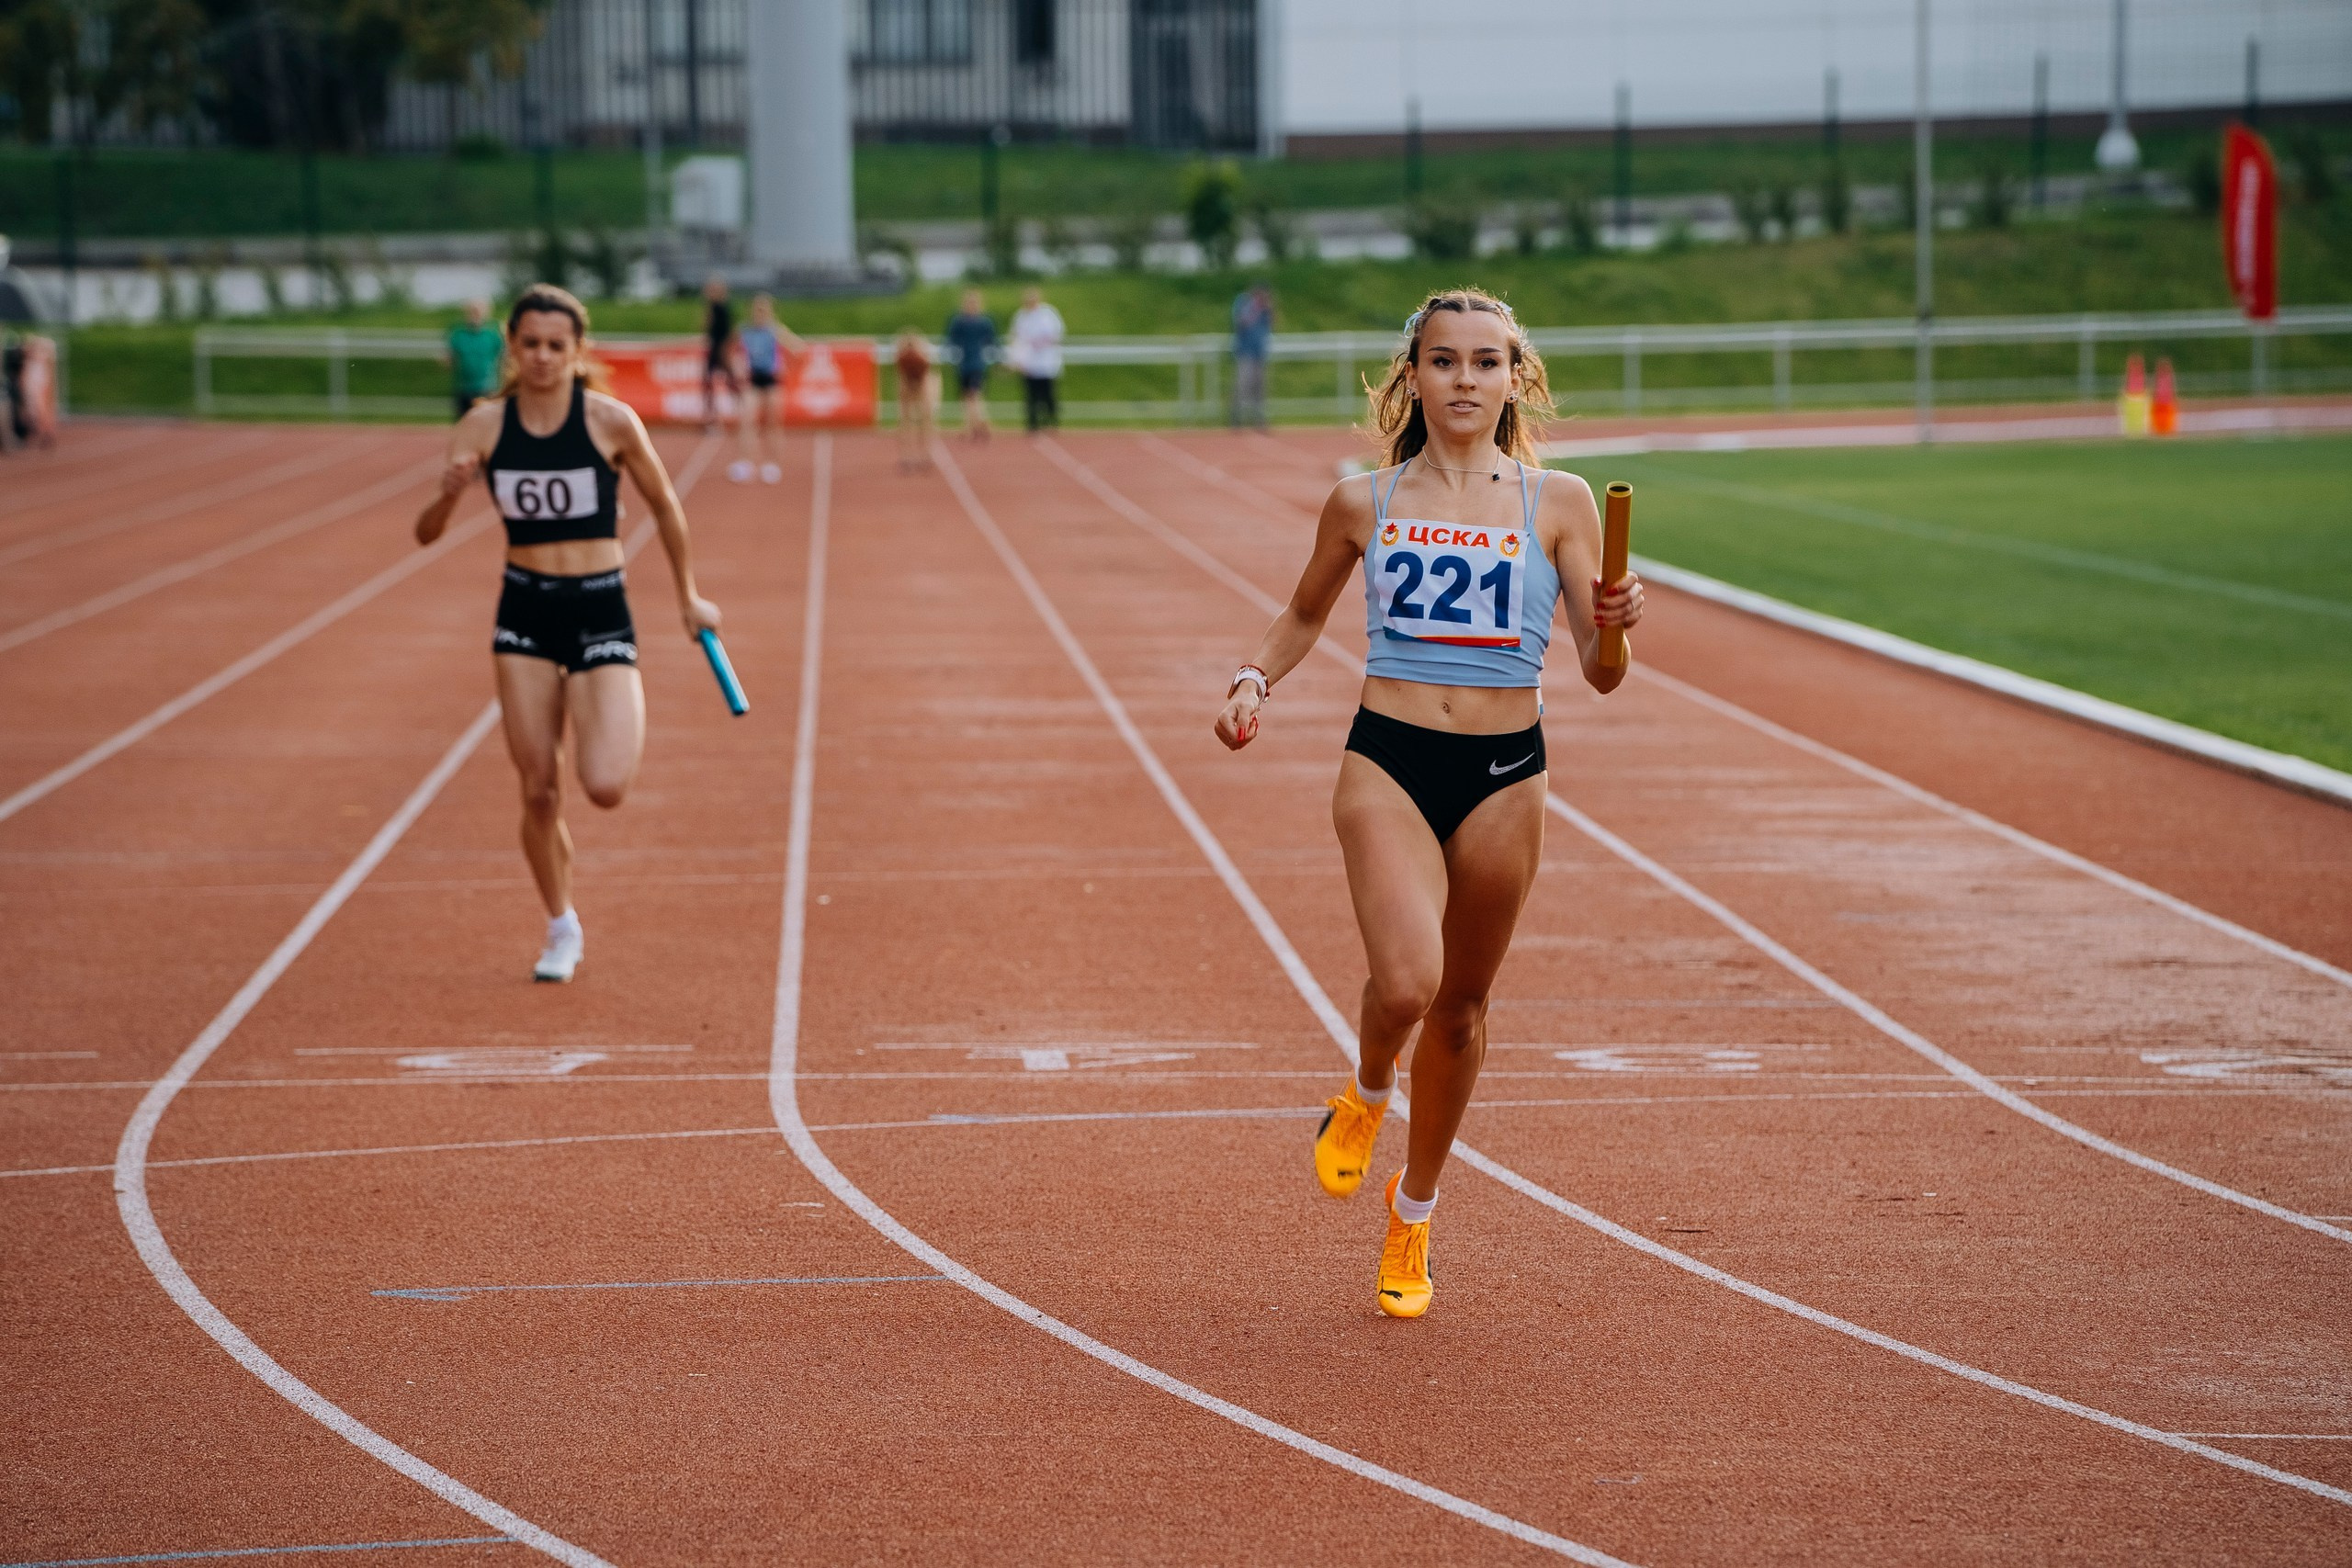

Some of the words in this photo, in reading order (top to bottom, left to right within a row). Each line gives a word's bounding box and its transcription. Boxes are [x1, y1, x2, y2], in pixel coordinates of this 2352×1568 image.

[516, 478, 571, 515] 60
[1408, 525, 1490, 547] ЦСКА
[1385, 551, 1511, 629] 221
